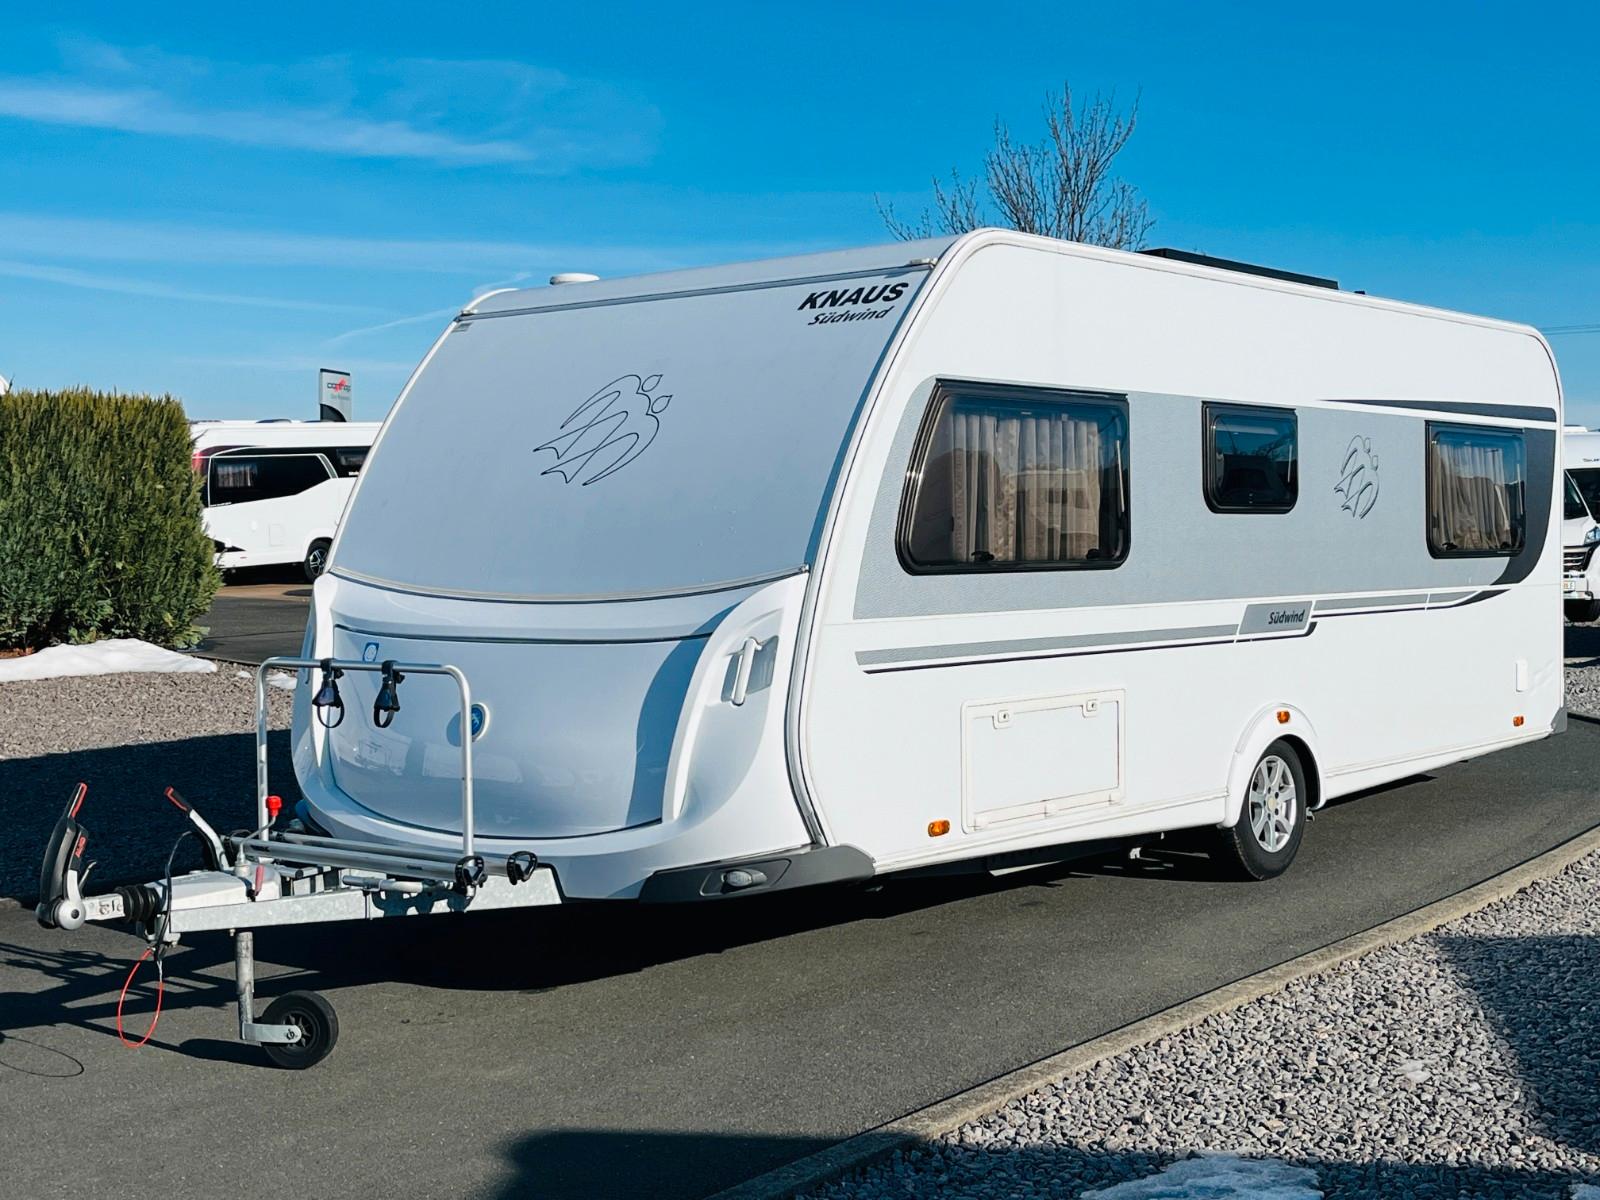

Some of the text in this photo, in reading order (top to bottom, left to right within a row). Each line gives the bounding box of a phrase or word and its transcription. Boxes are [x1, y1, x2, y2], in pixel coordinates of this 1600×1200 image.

[797, 282, 909, 311] KNAUS
[807, 305, 895, 326] Südwind
[1268, 609, 1305, 625] Südwind
